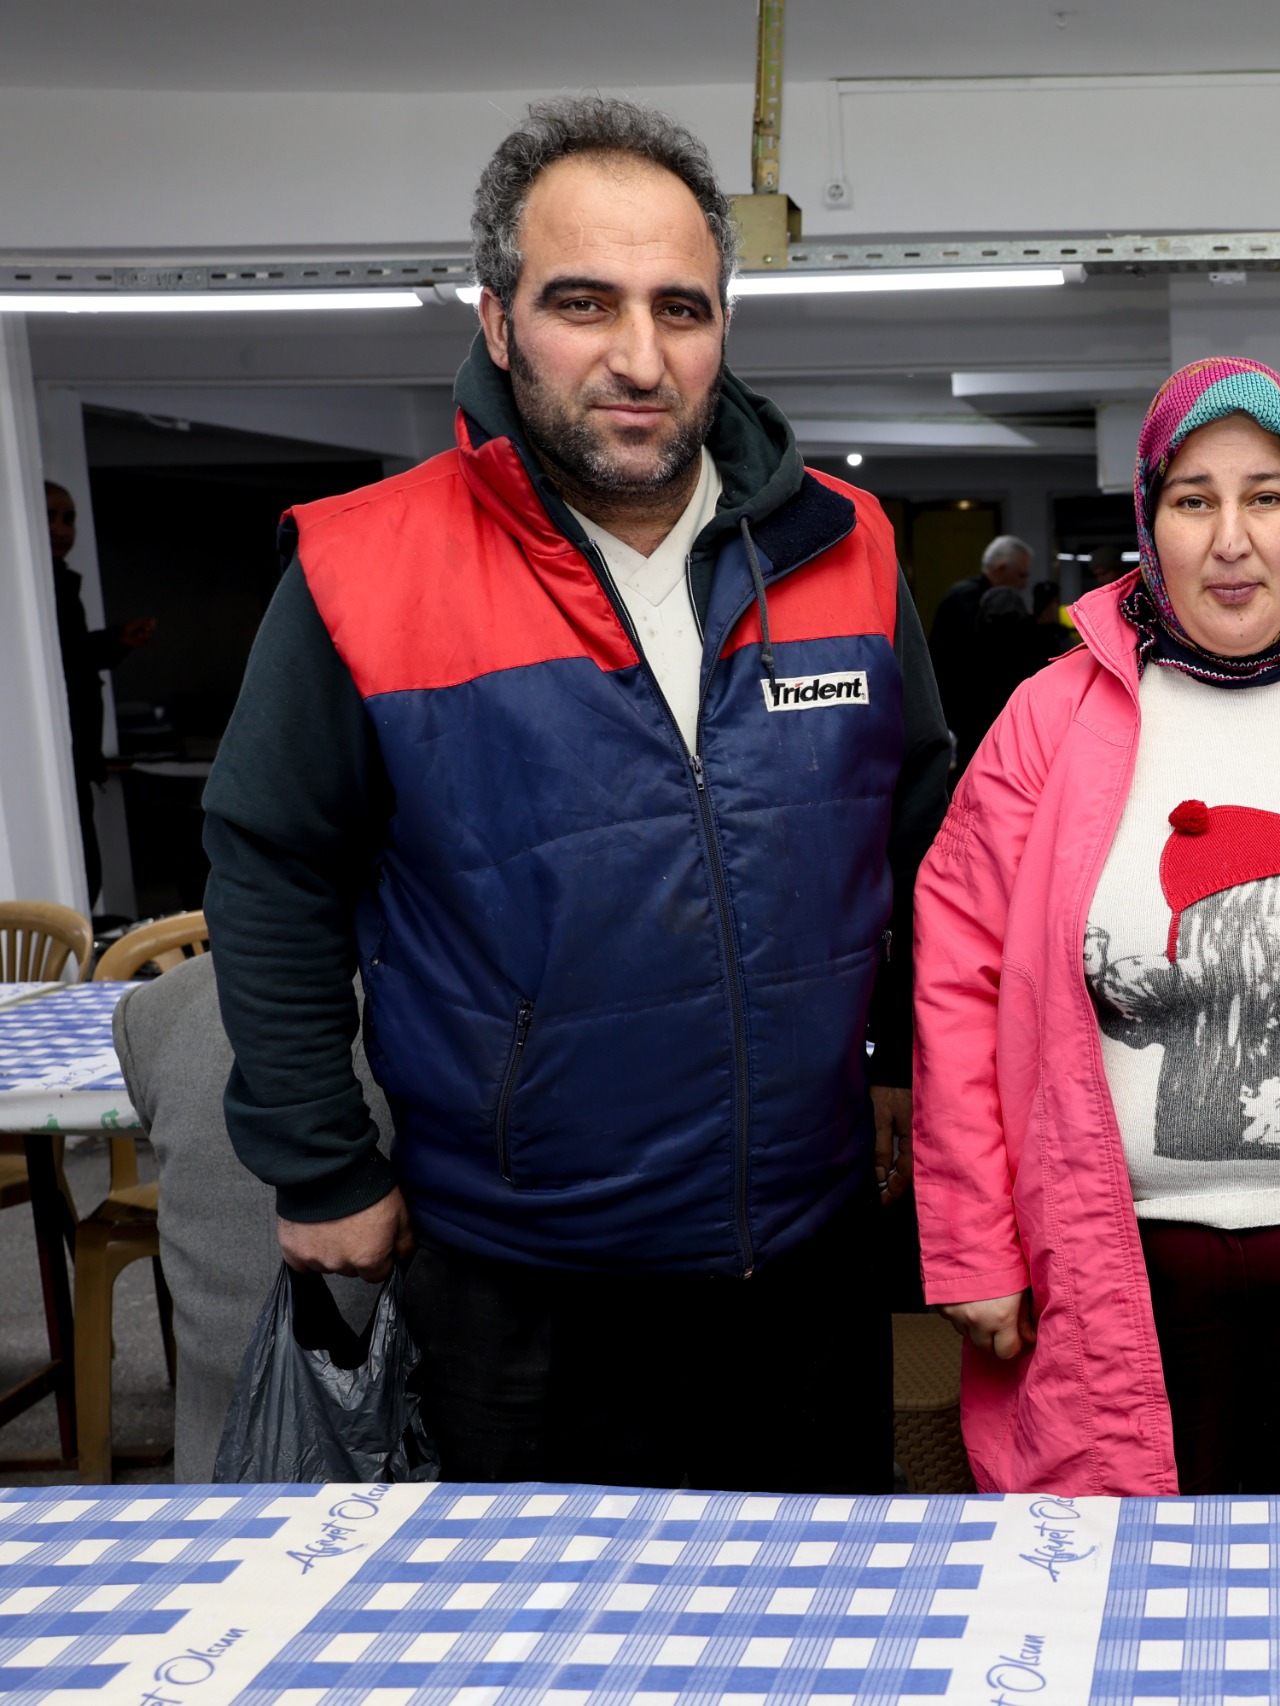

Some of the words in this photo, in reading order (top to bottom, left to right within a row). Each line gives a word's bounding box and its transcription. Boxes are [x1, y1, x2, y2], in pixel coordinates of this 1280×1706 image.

[768, 677, 863, 707] Trident
[153, 1627, 251, 1686] Olsun
[985, 1633, 1047, 1693] Olsun
